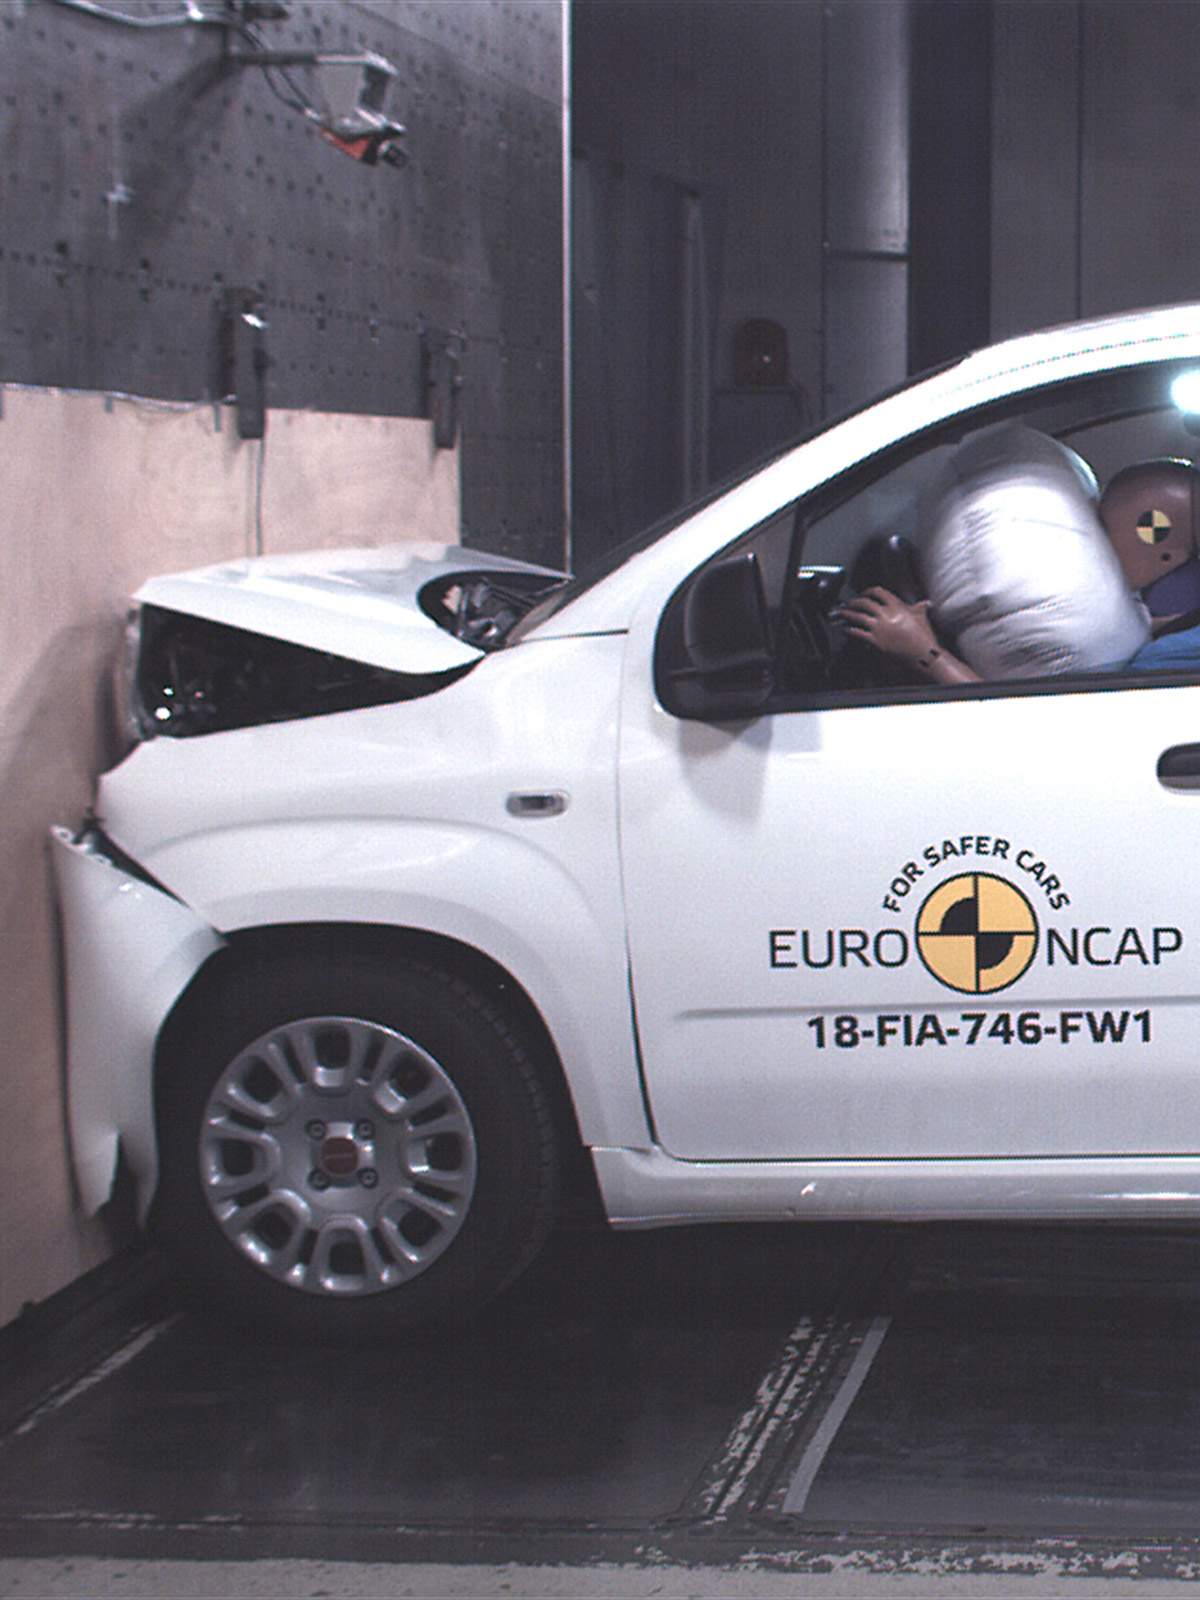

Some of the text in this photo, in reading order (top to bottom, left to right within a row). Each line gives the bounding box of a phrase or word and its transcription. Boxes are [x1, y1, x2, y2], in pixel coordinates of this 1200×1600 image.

[883, 836, 1071, 913] FOR SAFER CARS
[769, 927, 1183, 968] EURO NCAP
[807, 1009, 1152, 1048] 18-FIA-746-FW1
